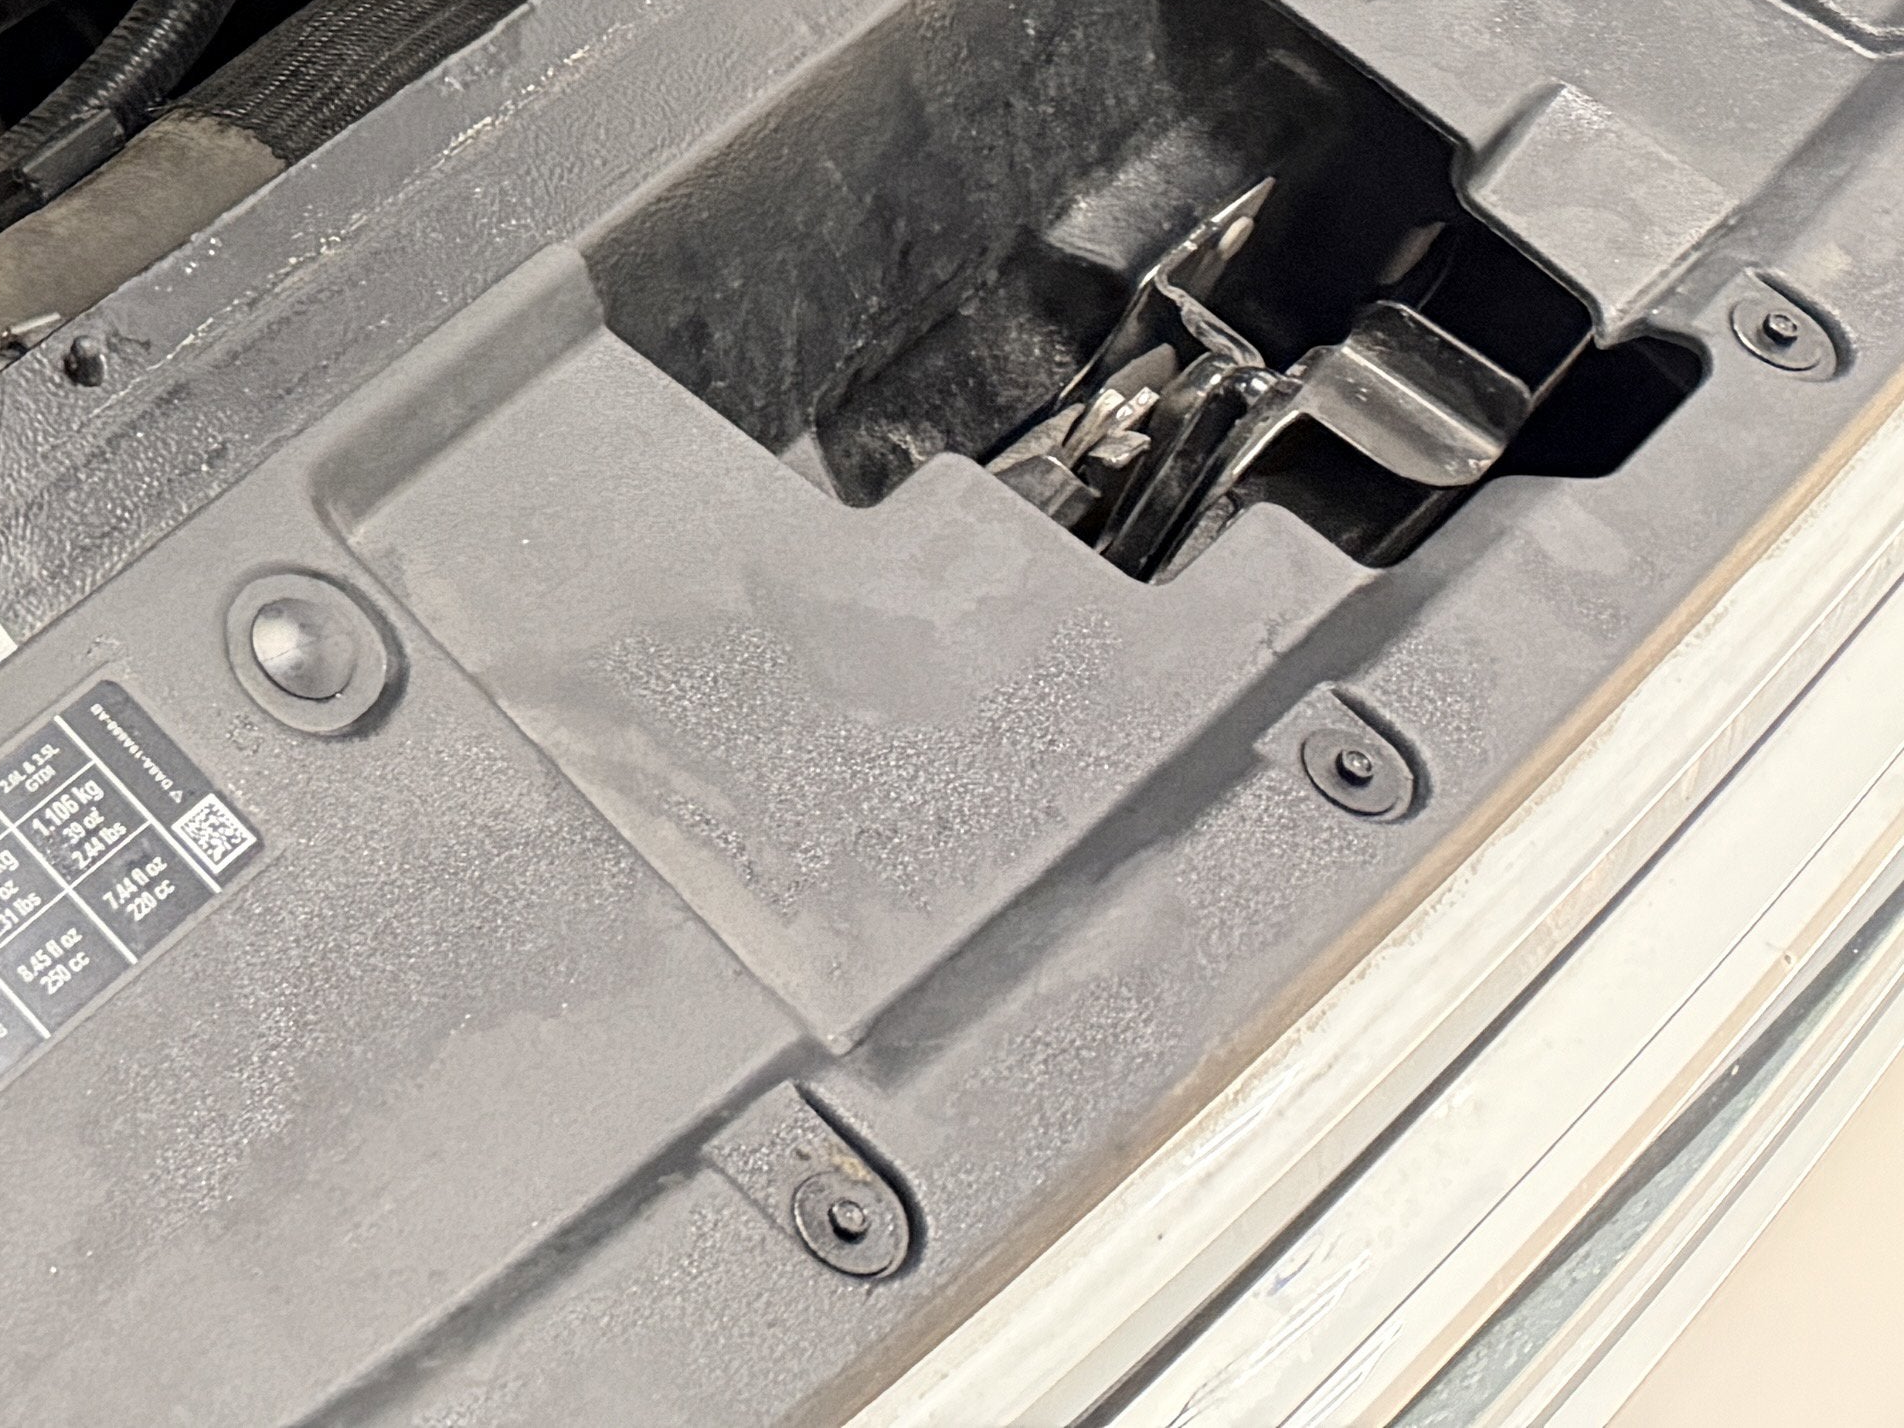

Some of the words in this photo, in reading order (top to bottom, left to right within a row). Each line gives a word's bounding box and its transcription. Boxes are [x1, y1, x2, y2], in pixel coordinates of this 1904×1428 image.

[29, 796, 78, 842] 1.106
[67, 774, 107, 814] kg
[61, 820, 88, 847] 39
[78, 805, 107, 833] oz
[69, 834, 108, 871] 2.44
[97, 816, 129, 847] lbs
[11, 887, 44, 919] lbs
[101, 874, 142, 912] 7.44
[142, 852, 170, 880] oz
[125, 890, 161, 924] 220
[150, 875, 179, 903] cc
[15, 946, 57, 986] 8.45
[56, 923, 85, 952] oz
[37, 961, 75, 997] 250
[64, 947, 92, 975] cc
